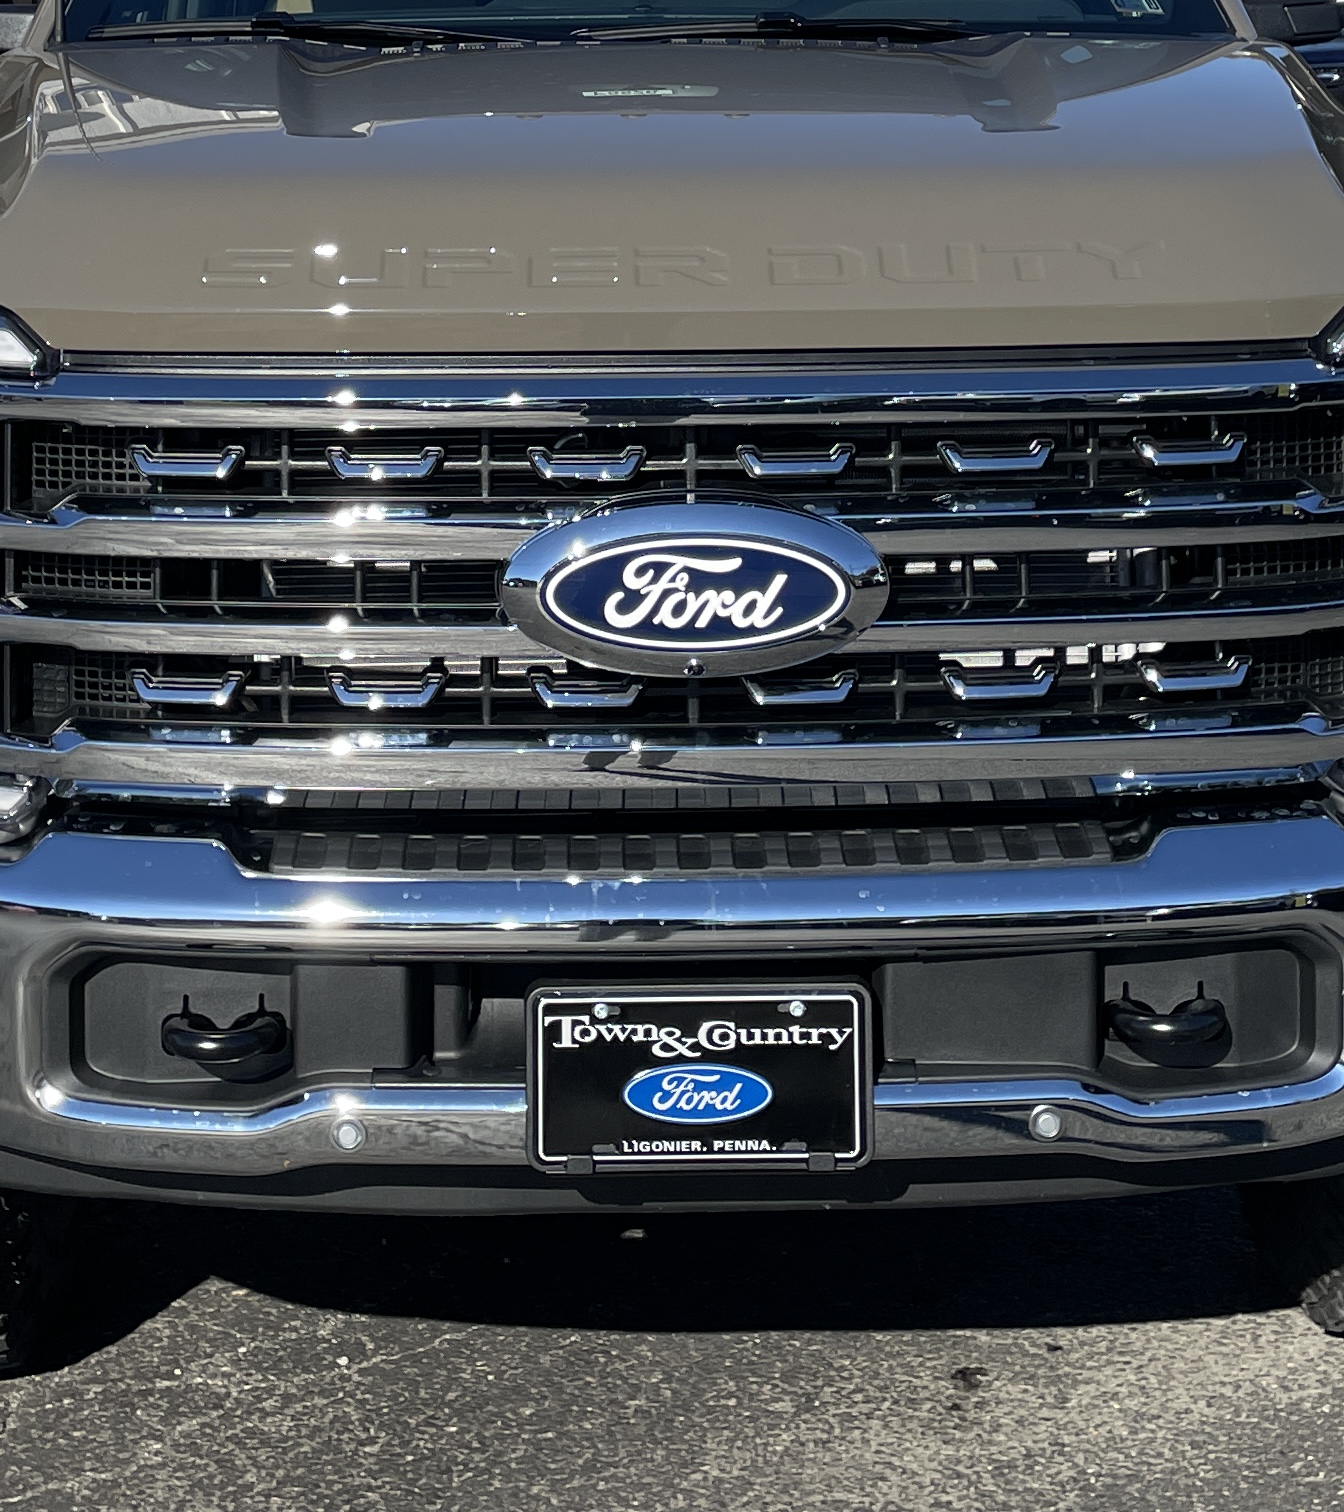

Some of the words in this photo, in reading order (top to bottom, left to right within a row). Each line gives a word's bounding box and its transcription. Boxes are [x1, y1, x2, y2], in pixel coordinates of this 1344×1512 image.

[200, 245, 730, 289] SUPER
[768, 238, 1166, 286] DUTY
[603, 554, 788, 629] Ford
[544, 1015, 659, 1049] Town
[651, 1026, 701, 1058] &
[698, 1020, 853, 1051] Country
[652, 1072, 744, 1111] Ford
[713, 1139, 777, 1152] PENNA.
